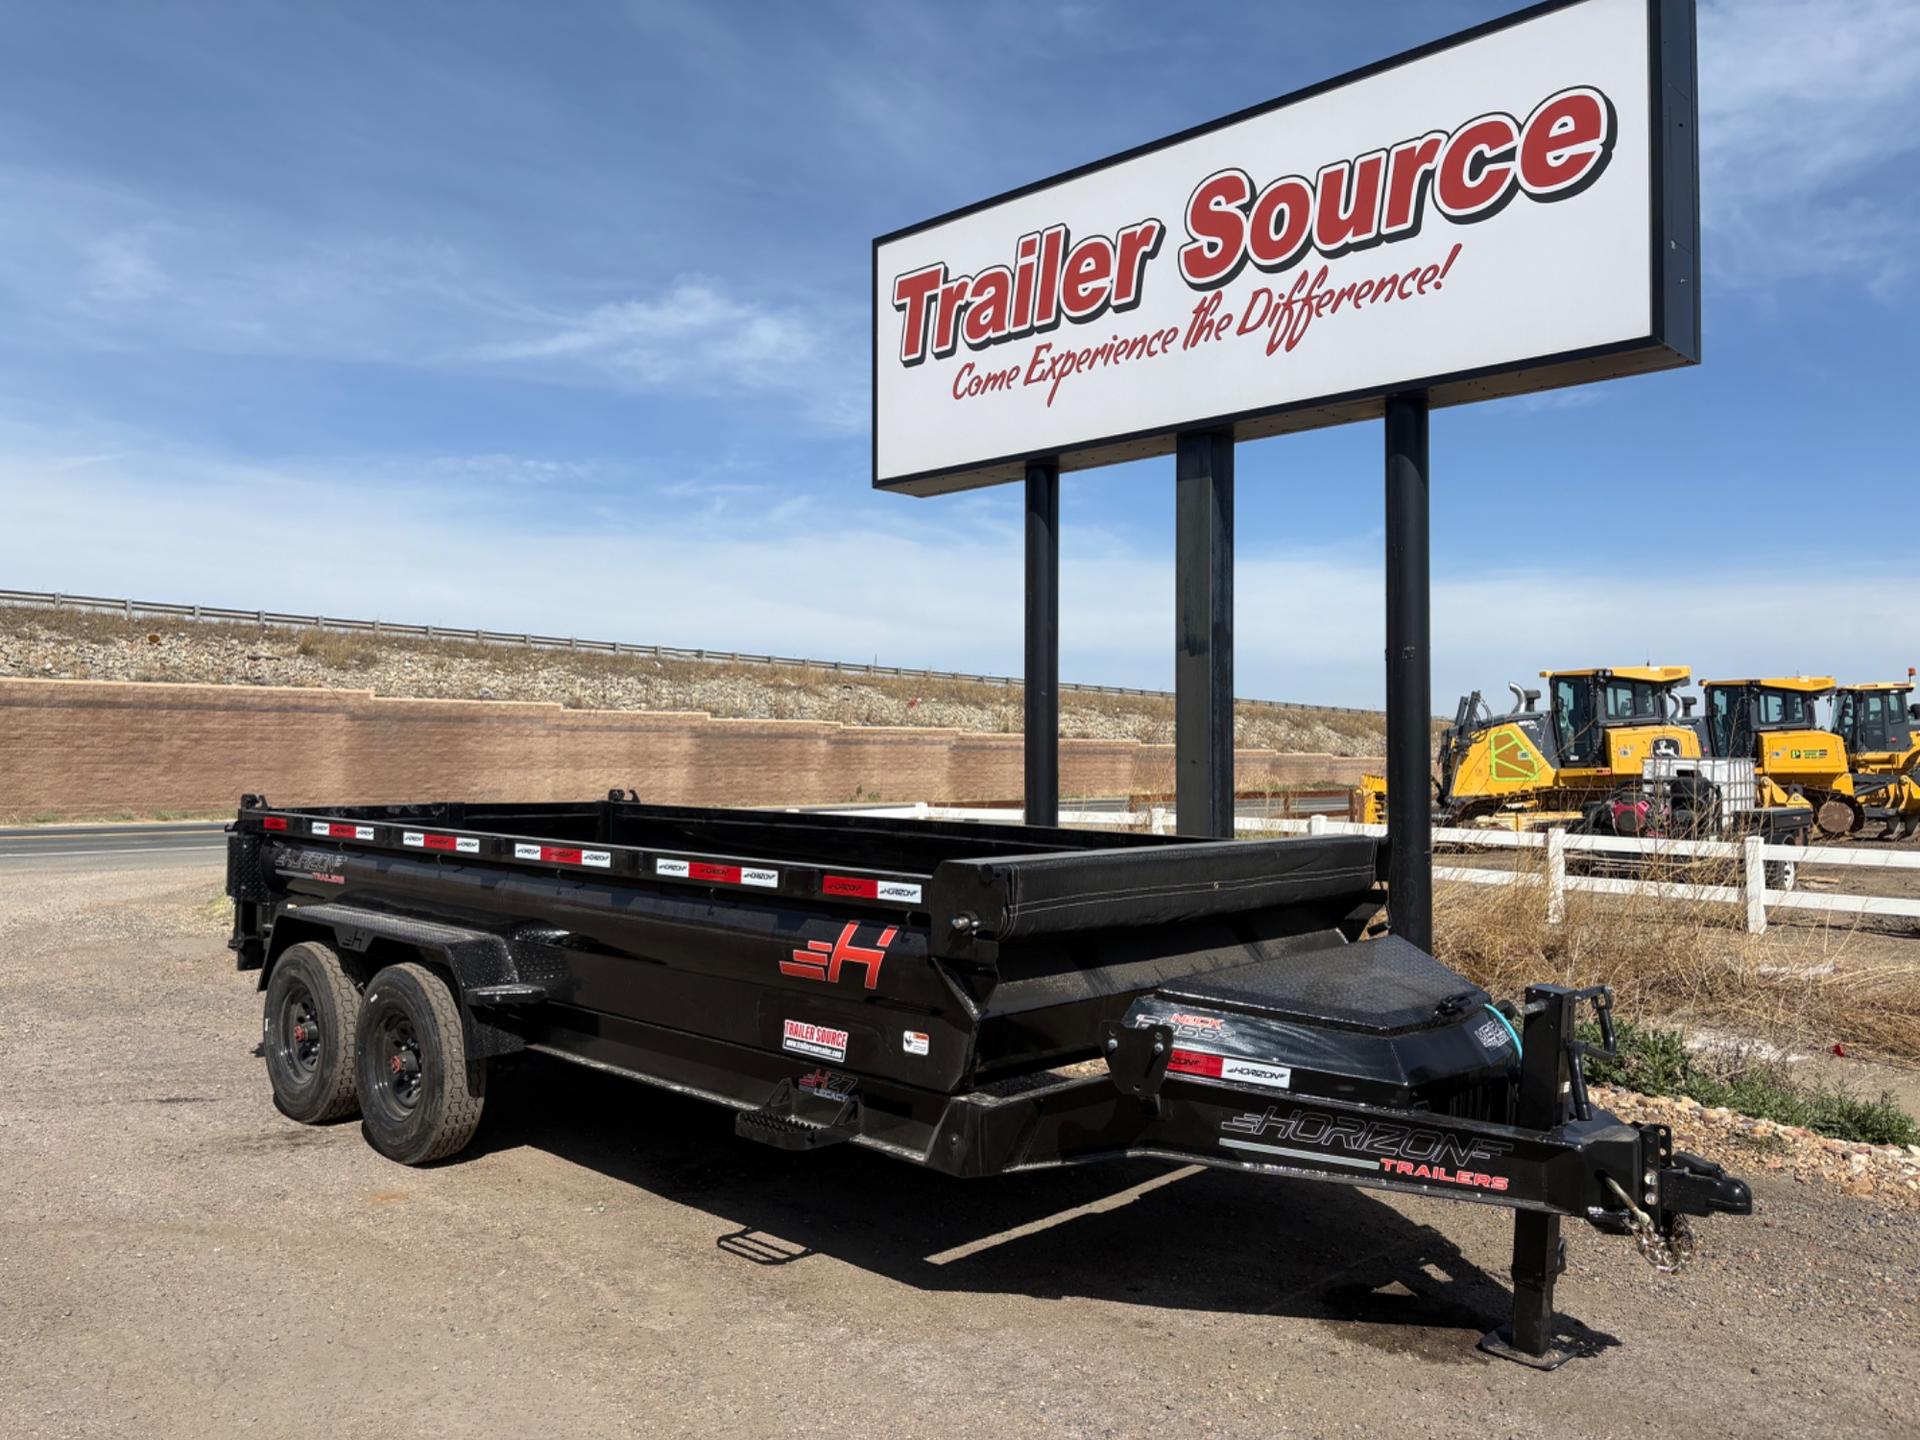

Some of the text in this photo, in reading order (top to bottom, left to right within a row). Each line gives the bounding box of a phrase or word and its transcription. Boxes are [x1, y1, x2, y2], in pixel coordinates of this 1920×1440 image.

[893, 85, 1617, 366] Trailer Source
[952, 243, 1463, 407] Come Experience the Difference!
[784, 1021, 847, 1048] TRAILER SOURCE
[1229, 1066, 1284, 1081] HORIZON
[1251, 1106, 1481, 1168] HORIZON
[1380, 1158, 1510, 1191] TRAILERS
